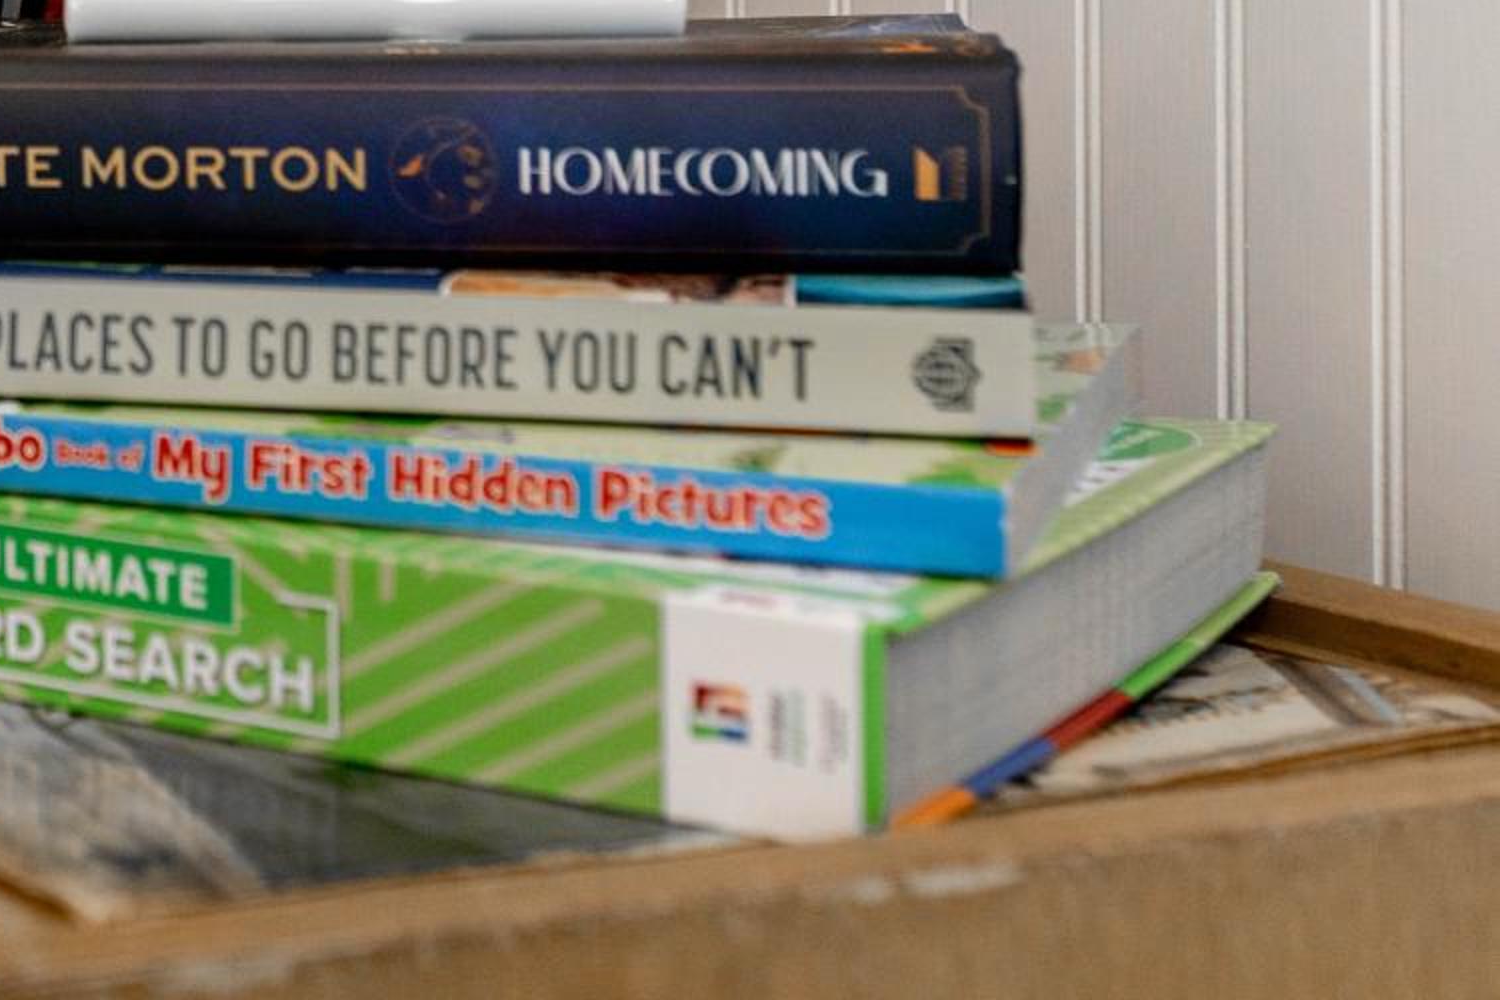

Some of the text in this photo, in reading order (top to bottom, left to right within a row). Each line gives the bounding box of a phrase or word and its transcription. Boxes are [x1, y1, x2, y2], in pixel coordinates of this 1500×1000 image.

[81, 145, 367, 191] MORTON
[517, 147, 889, 197] HOMECOMING
[172, 315, 230, 379] TO
[248, 318, 311, 382] GO
[331, 321, 519, 391] BEFORE
[537, 328, 638, 395] YOU
[659, 333, 815, 400] CAN'T
[155, 434, 230, 500] My
[248, 443, 372, 498] First
[391, 452, 577, 513] Hidden
[599, 468, 830, 537] Pictures
[65, 619, 316, 713] SEARCH
